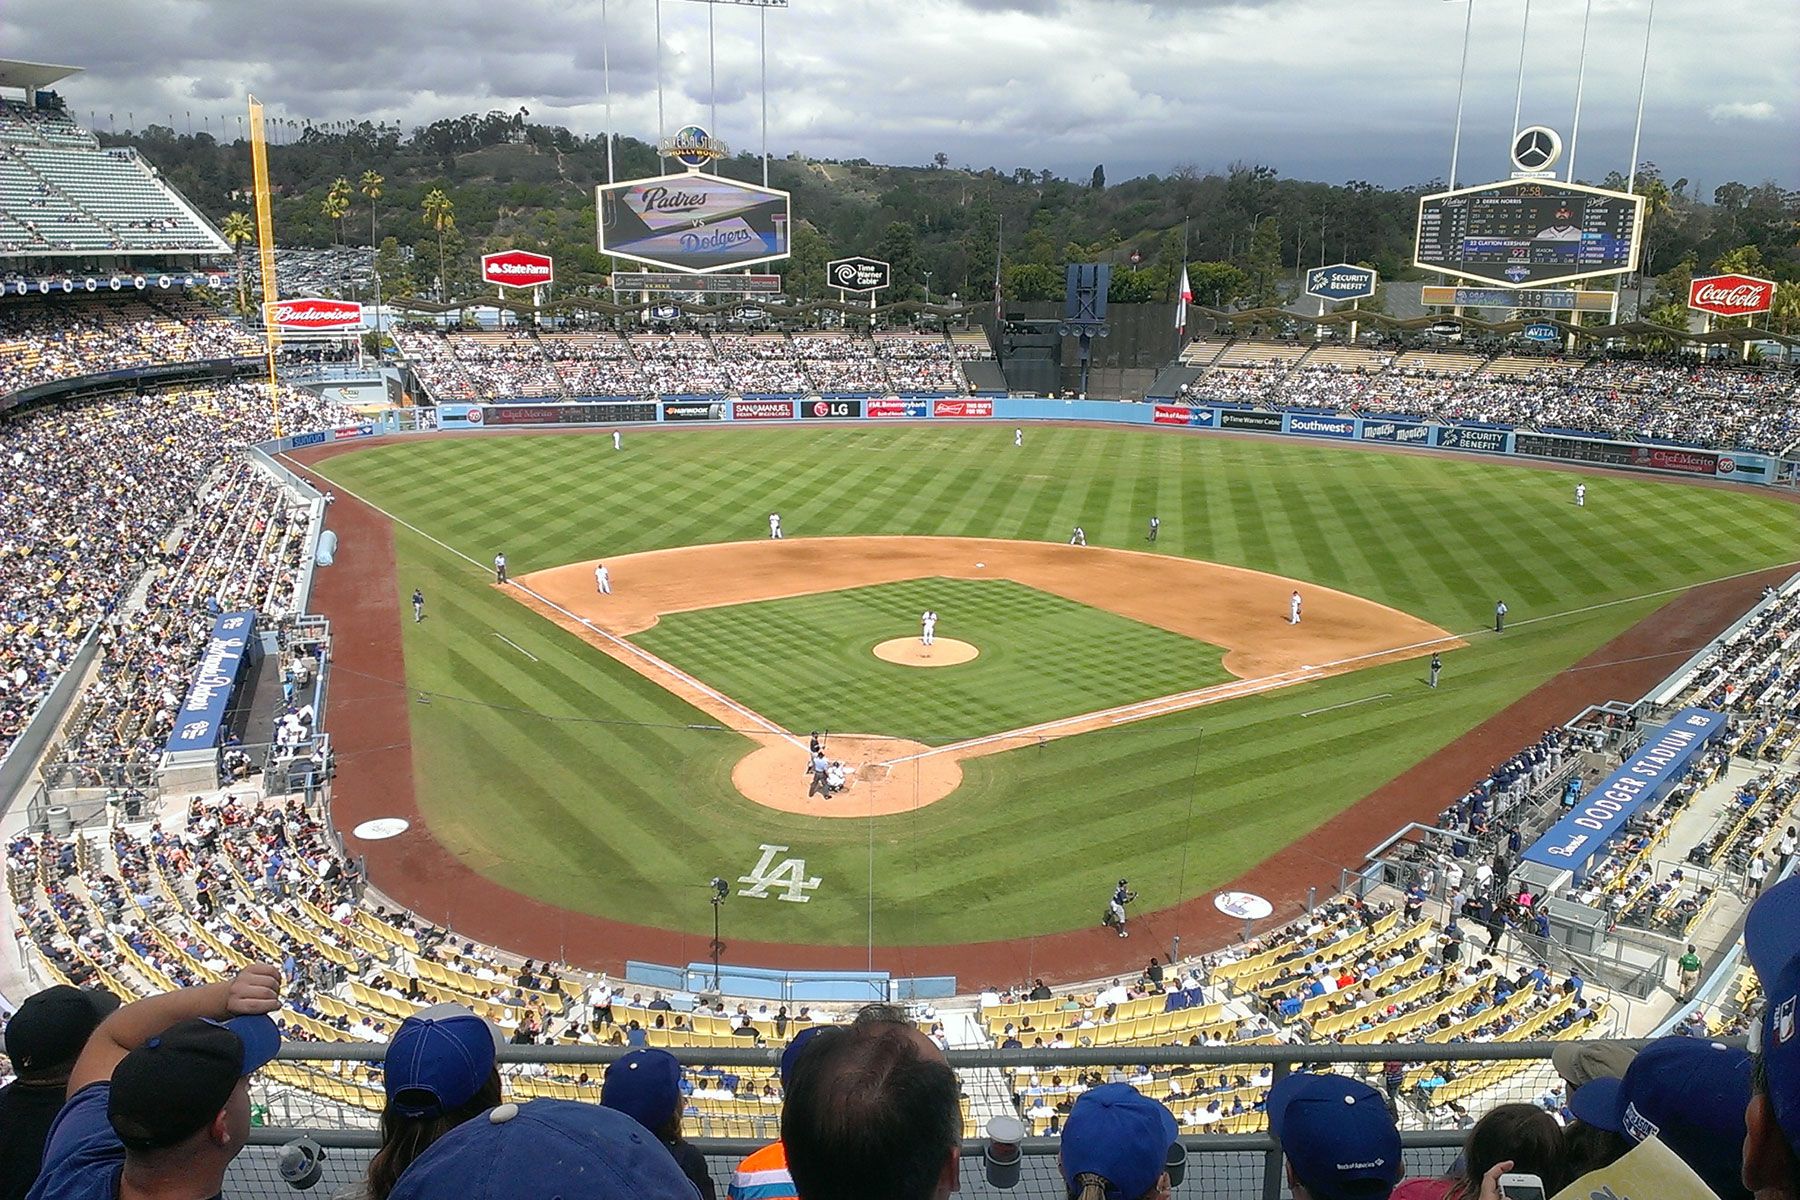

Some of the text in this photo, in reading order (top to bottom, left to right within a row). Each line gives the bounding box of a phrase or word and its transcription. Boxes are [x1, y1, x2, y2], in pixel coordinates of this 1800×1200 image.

[658, 134, 730, 153] UNIVERSAL STUDIOS
[669, 149, 721, 158] HOLLYWOOD
[1515, 186, 1541, 197] 12:58
[642, 187, 707, 212] Padres
[680, 227, 751, 252] Dodgers
[502, 264, 550, 274] State Farm
[1331, 273, 1369, 282] SECURITY
[1330, 282, 1366, 290] BENEFIT
[1695, 284, 1766, 306] Coca-Cola
[269, 307, 360, 322] Budweiser
[1527, 328, 1554, 337] AVITA
[736, 404, 791, 412] SAN MANUEL
[831, 404, 848, 415] LG
[469, 412, 480, 420] 76
[502, 409, 523, 419] Chef
[526, 409, 553, 418] Merito
[1155, 411, 1170, 419] Bank
[1176, 412, 1198, 421] America
[1228, 415, 1281, 426] Time Warner Cable
[1291, 419, 1346, 433] Southwest
[1364, 423, 1395, 438] Montejo
[1396, 426, 1428, 441] Montejo
[1461, 430, 1503, 442] SECURITY
[294, 434, 323, 446] sunrun
[1459, 439, 1498, 450] BENEFIT
[1654, 450, 1714, 466] Chef Merito
[1719, 460, 1733, 470] 76
[1574, 729, 1695, 830] DODGER STADIUM
[737, 844, 823, 902] LA
